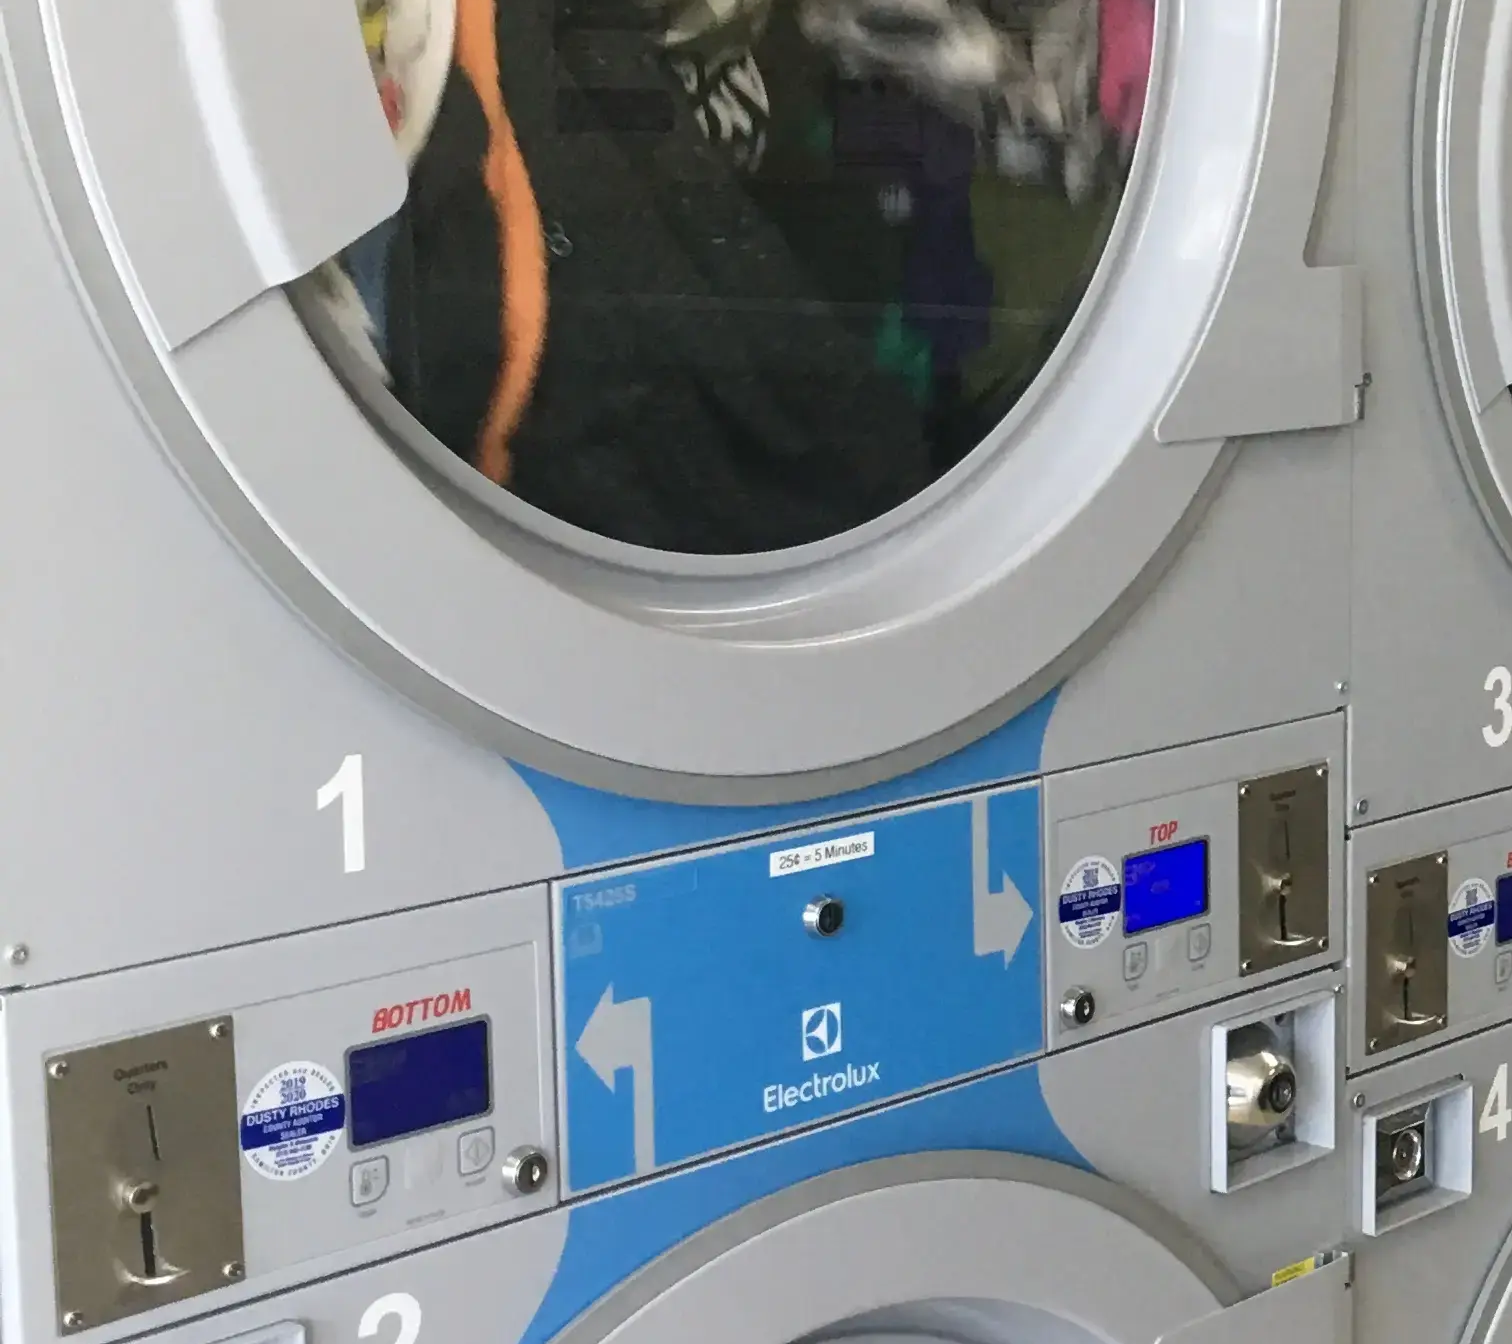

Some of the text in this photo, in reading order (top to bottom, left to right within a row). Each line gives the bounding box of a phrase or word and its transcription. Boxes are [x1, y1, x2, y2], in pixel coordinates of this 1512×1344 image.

[316, 754, 366, 874] 1
[1149, 820, 1179, 845] TOP
[778, 853, 800, 870] 25¢
[814, 848, 822, 862] 5
[824, 841, 868, 859] Minutes
[371, 988, 472, 1034] BOTTOM
[763, 1061, 880, 1113] Electrolux
[1478, 1063, 1512, 1141] 4
[246, 1096, 340, 1127] DUSTY RHODES
